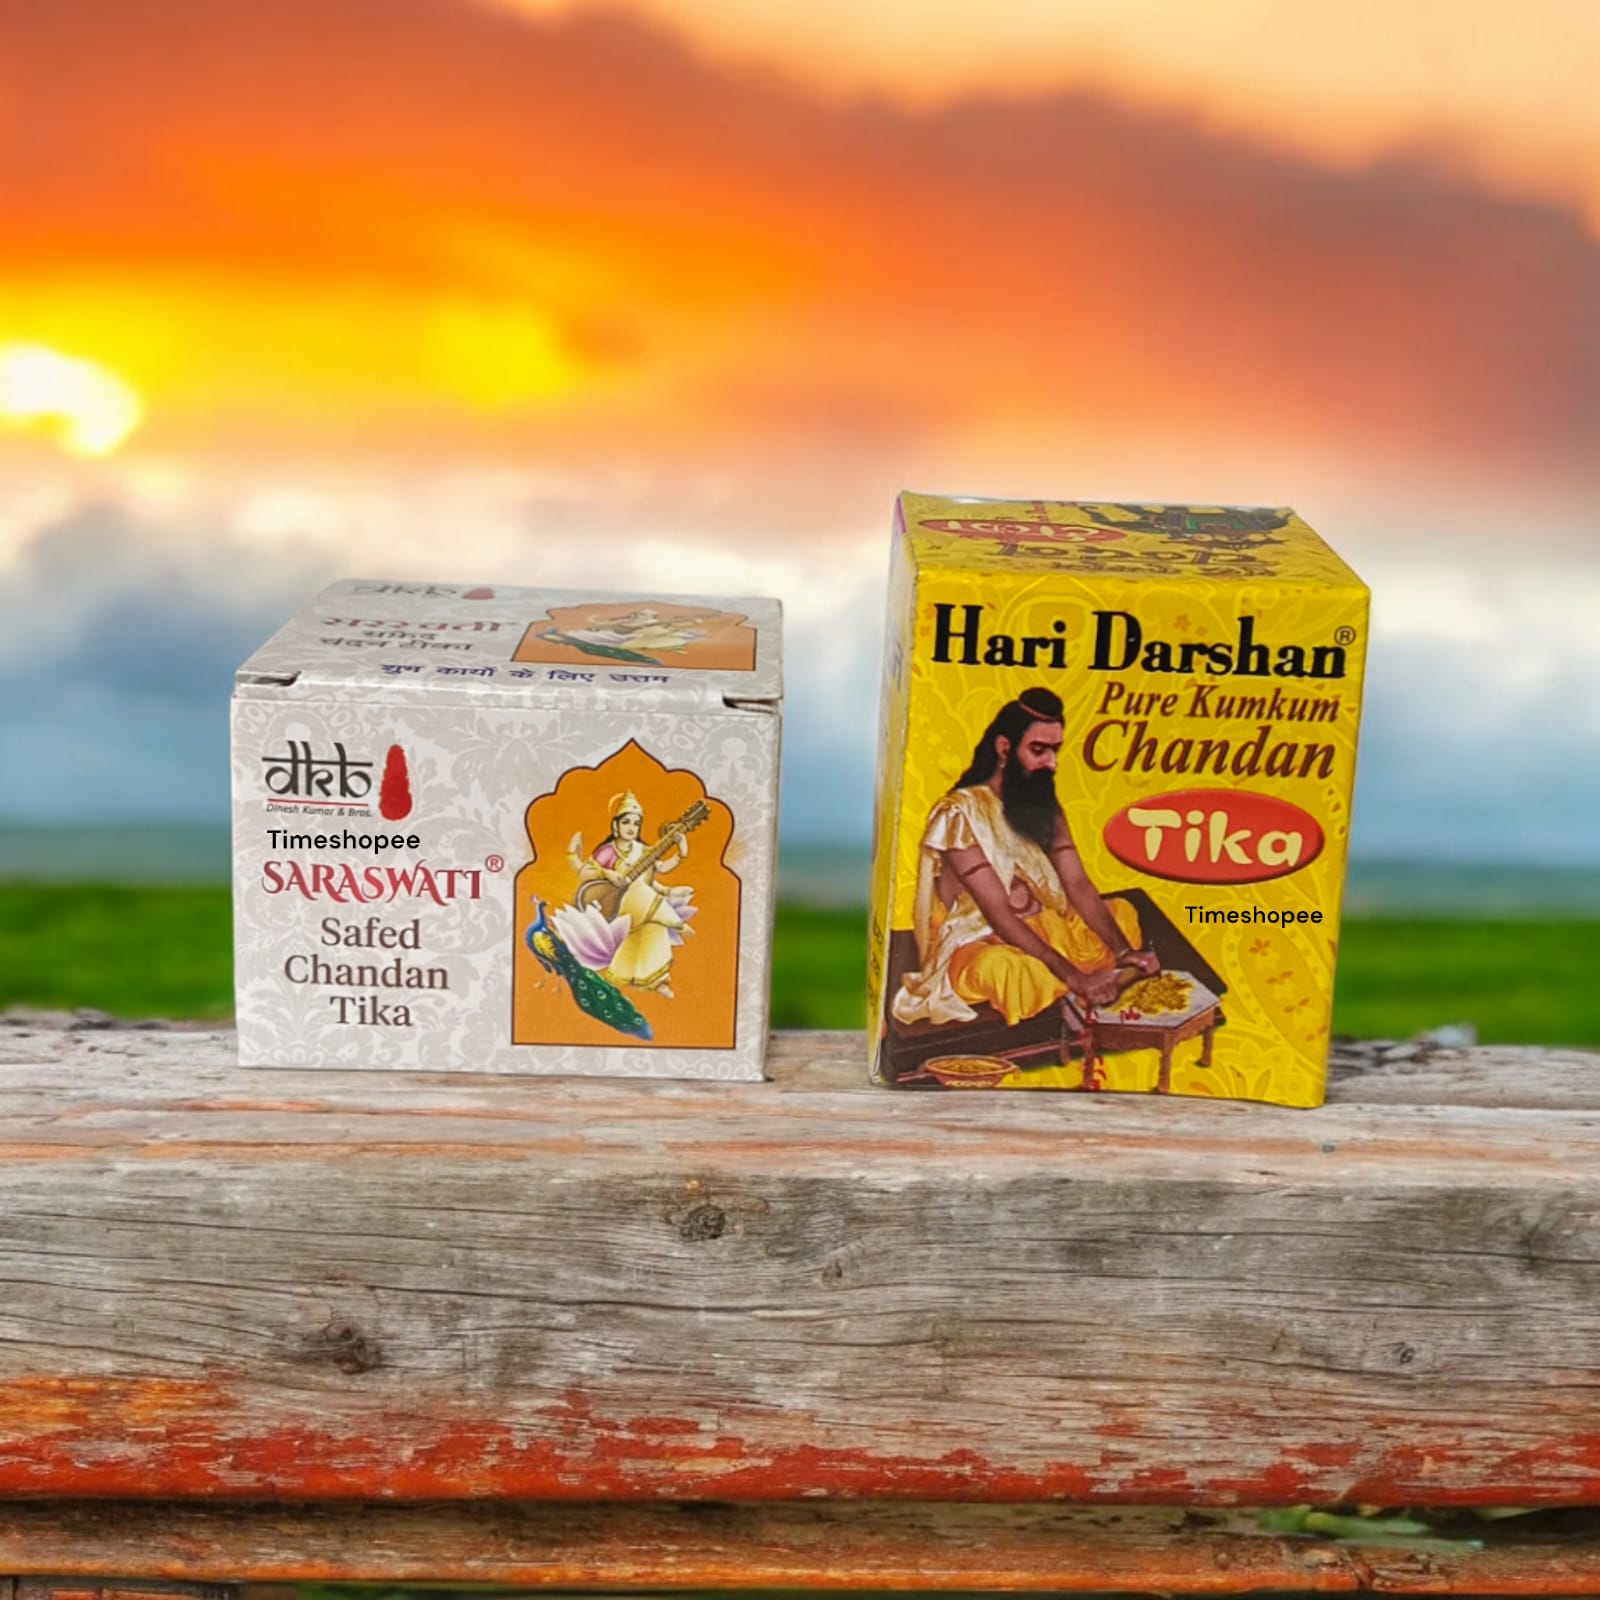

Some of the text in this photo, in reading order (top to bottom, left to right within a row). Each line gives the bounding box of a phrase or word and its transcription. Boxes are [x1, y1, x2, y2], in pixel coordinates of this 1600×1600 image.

[931, 603, 1066, 669] Hari
[1088, 610, 1346, 679] Darshan
[508, 667, 536, 679] के
[547, 669, 597, 682] लिए
[1096, 681, 1340, 723] Pure Kumkum
[262, 740, 374, 798] dkb
[1083, 719, 1337, 780] Chandan
[266, 803, 299, 814] Dinesh
[302, 805, 335, 816] Kumar
[337, 807, 345, 816] &
[1127, 807, 1304, 867] Tika
[262, 858, 482, 907] SARASWATI
[321, 916, 422, 949] Safed
[284, 954, 450, 990] Chandan
[330, 995, 414, 1028] Tika
